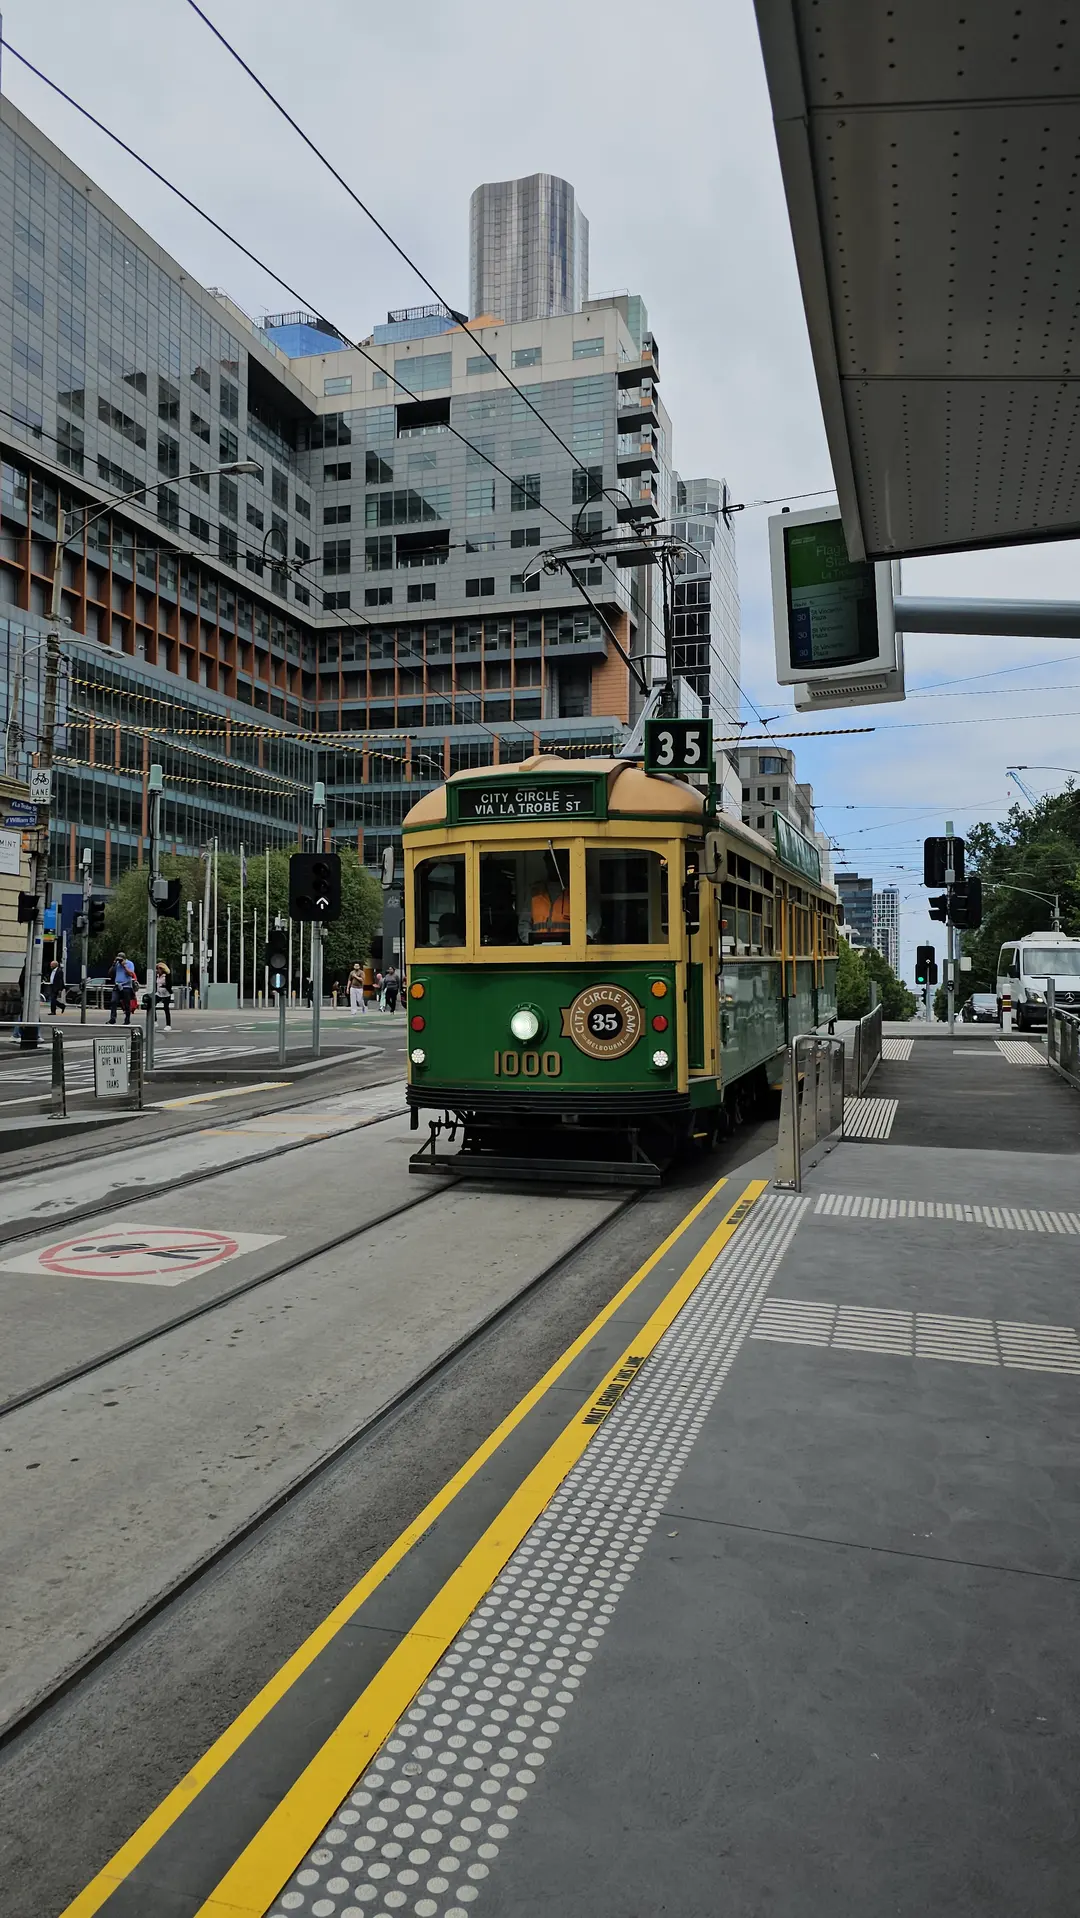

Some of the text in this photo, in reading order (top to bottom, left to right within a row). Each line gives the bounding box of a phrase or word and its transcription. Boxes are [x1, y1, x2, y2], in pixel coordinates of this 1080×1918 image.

[481, 792, 509, 804] CITY
[515, 790, 560, 803] CIRCLE
[21, 802, 32, 811] Trobe
[474, 801, 581, 815] VIA LA TROBE ST
[574, 991, 636, 1034] CITY CIRCLE TRAM
[592, 1013, 618, 1031] 35
[98, 1045, 125, 1054] PEDESTRIANS
[586, 1039, 626, 1051] MELBOURNE
[101, 1057, 122, 1066] GIVE WAY
[494, 1050, 561, 1076] 1000
[109, 1068, 115, 1077] TO
[106, 1079, 120, 1089] TRAMS
[581, 1407, 609, 1424] WAIT
[596, 1383, 625, 1407] BEHIND
[612, 1368, 635, 1382] THIS
